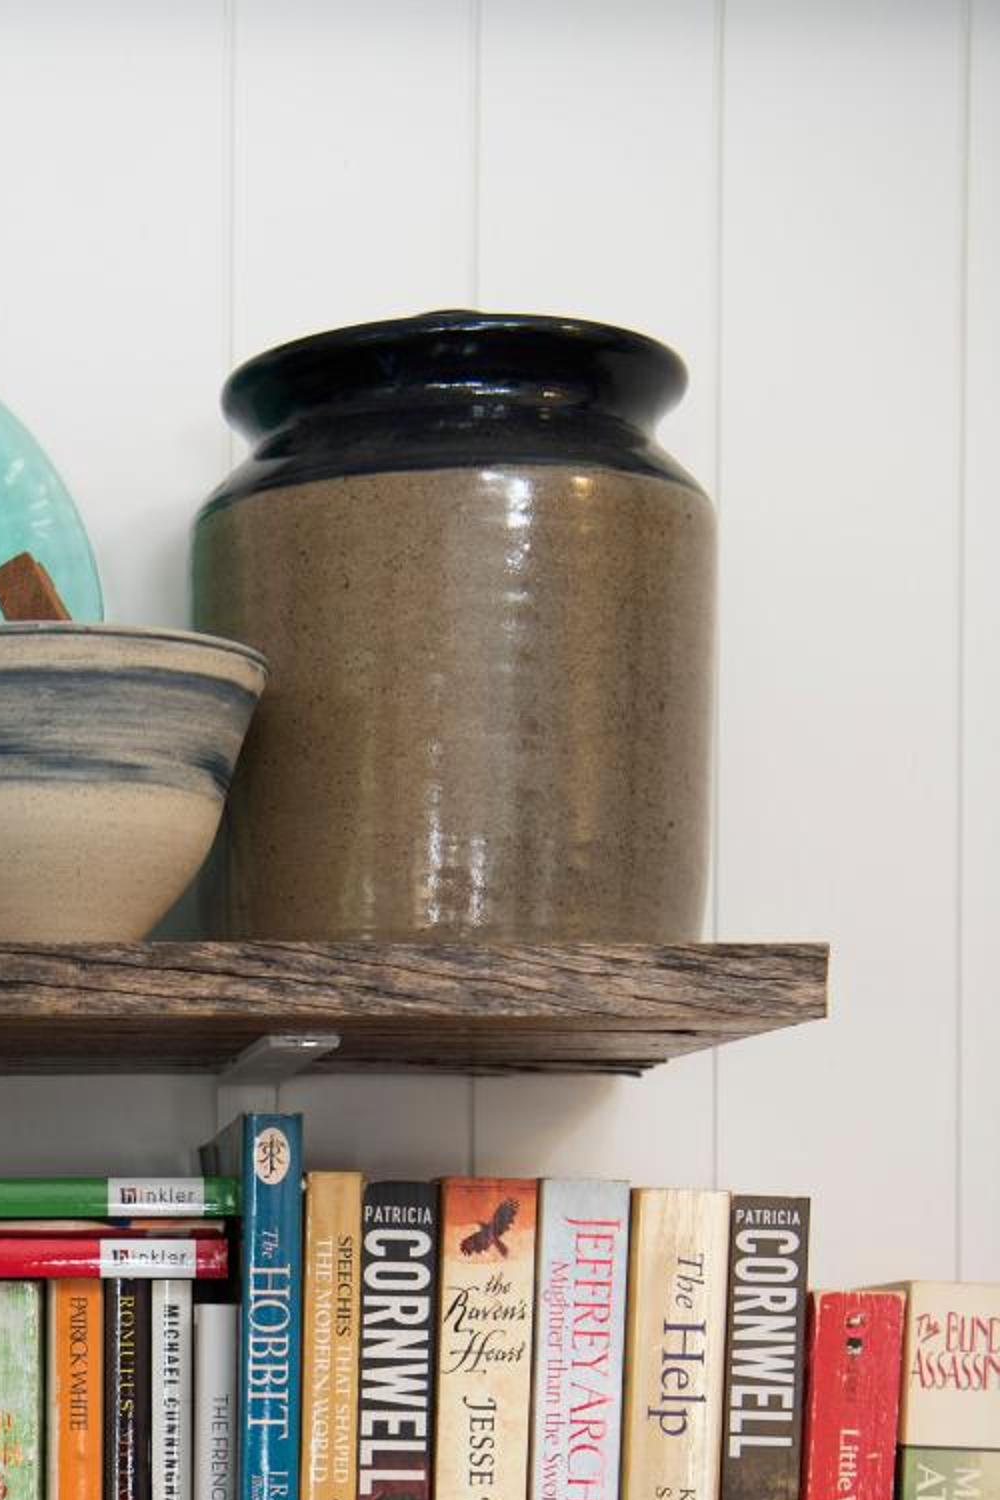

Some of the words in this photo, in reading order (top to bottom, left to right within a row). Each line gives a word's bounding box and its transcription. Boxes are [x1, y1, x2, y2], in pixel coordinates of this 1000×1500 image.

[262, 1228, 279, 1260] The
[364, 1204, 433, 1225] PATRICIA
[735, 1209, 801, 1226] PATRICIA
[315, 1238, 333, 1281] THE
[337, 1235, 353, 1337] SPEECHES
[483, 1274, 512, 1295] the
[675, 1253, 706, 1310] The
[442, 1286, 528, 1333] Raven's
[542, 1259, 571, 1350] Mightier
[567, 1216, 622, 1377] JEFFREY
[69, 1296, 89, 1367] PATRICK
[247, 1264, 291, 1439] HOBBIT
[312, 1290, 332, 1389] MODERN
[359, 1228, 433, 1495] CORNWELL
[440, 1329, 526, 1375] Heart
[728, 1229, 801, 1460] CORNWELL
[335, 1343, 352, 1396] THAT
[546, 1358, 569, 1404] than
[648, 1320, 708, 1438] Help
[69, 1371, 89, 1431] WHITE
[210, 1395, 229, 1431] THE
[543, 1412, 566, 1446] the
[311, 1397, 330, 1484] WORLD
[333, 1403, 349, 1484] SHAPED
[462, 1395, 498, 1486] JESSE
[838, 1428, 861, 1492] Little
